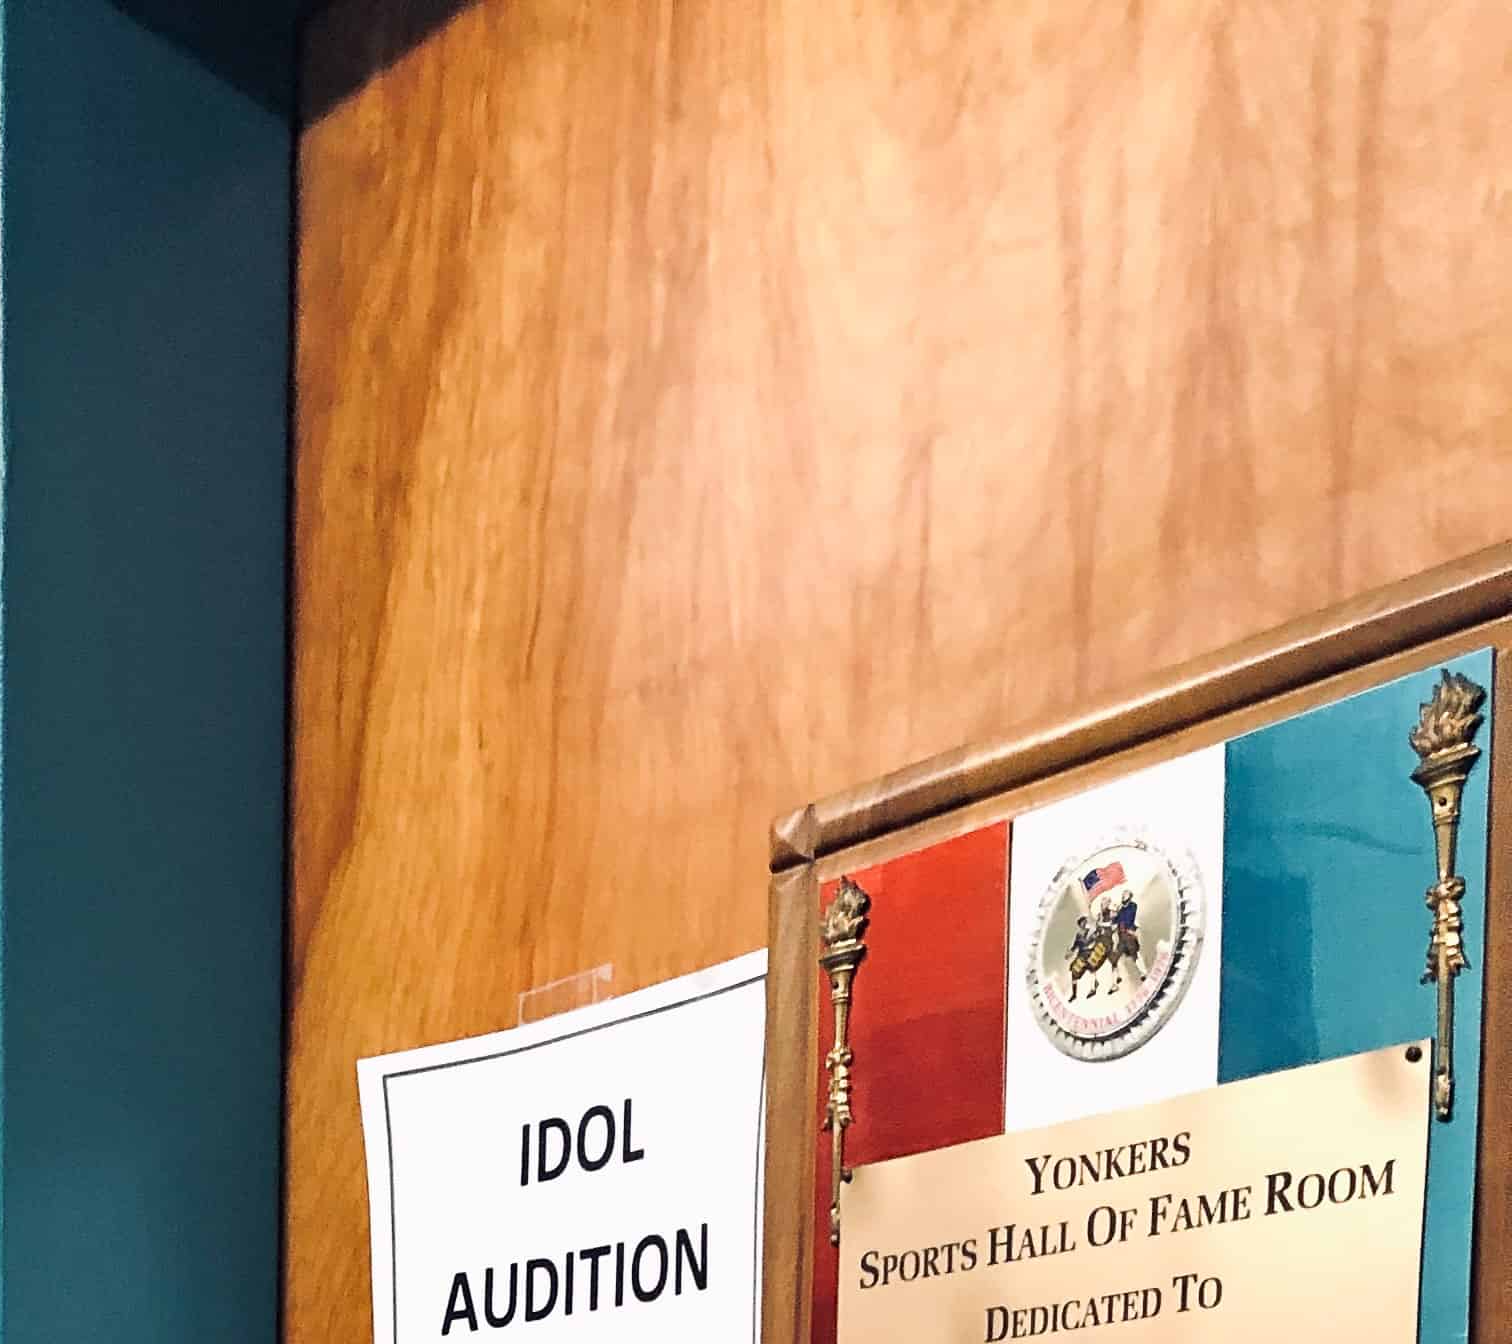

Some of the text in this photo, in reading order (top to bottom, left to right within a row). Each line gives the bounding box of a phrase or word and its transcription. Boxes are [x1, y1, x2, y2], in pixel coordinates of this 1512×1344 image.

[520, 1098, 645, 1187] IDOL
[1024, 1131, 1191, 1196] YONKERS
[858, 1159, 1396, 1289] SPORTS HALL OF FAME ROOM
[440, 1223, 709, 1336] AUDITION
[984, 1272, 1224, 1343] DEDICATED TO
